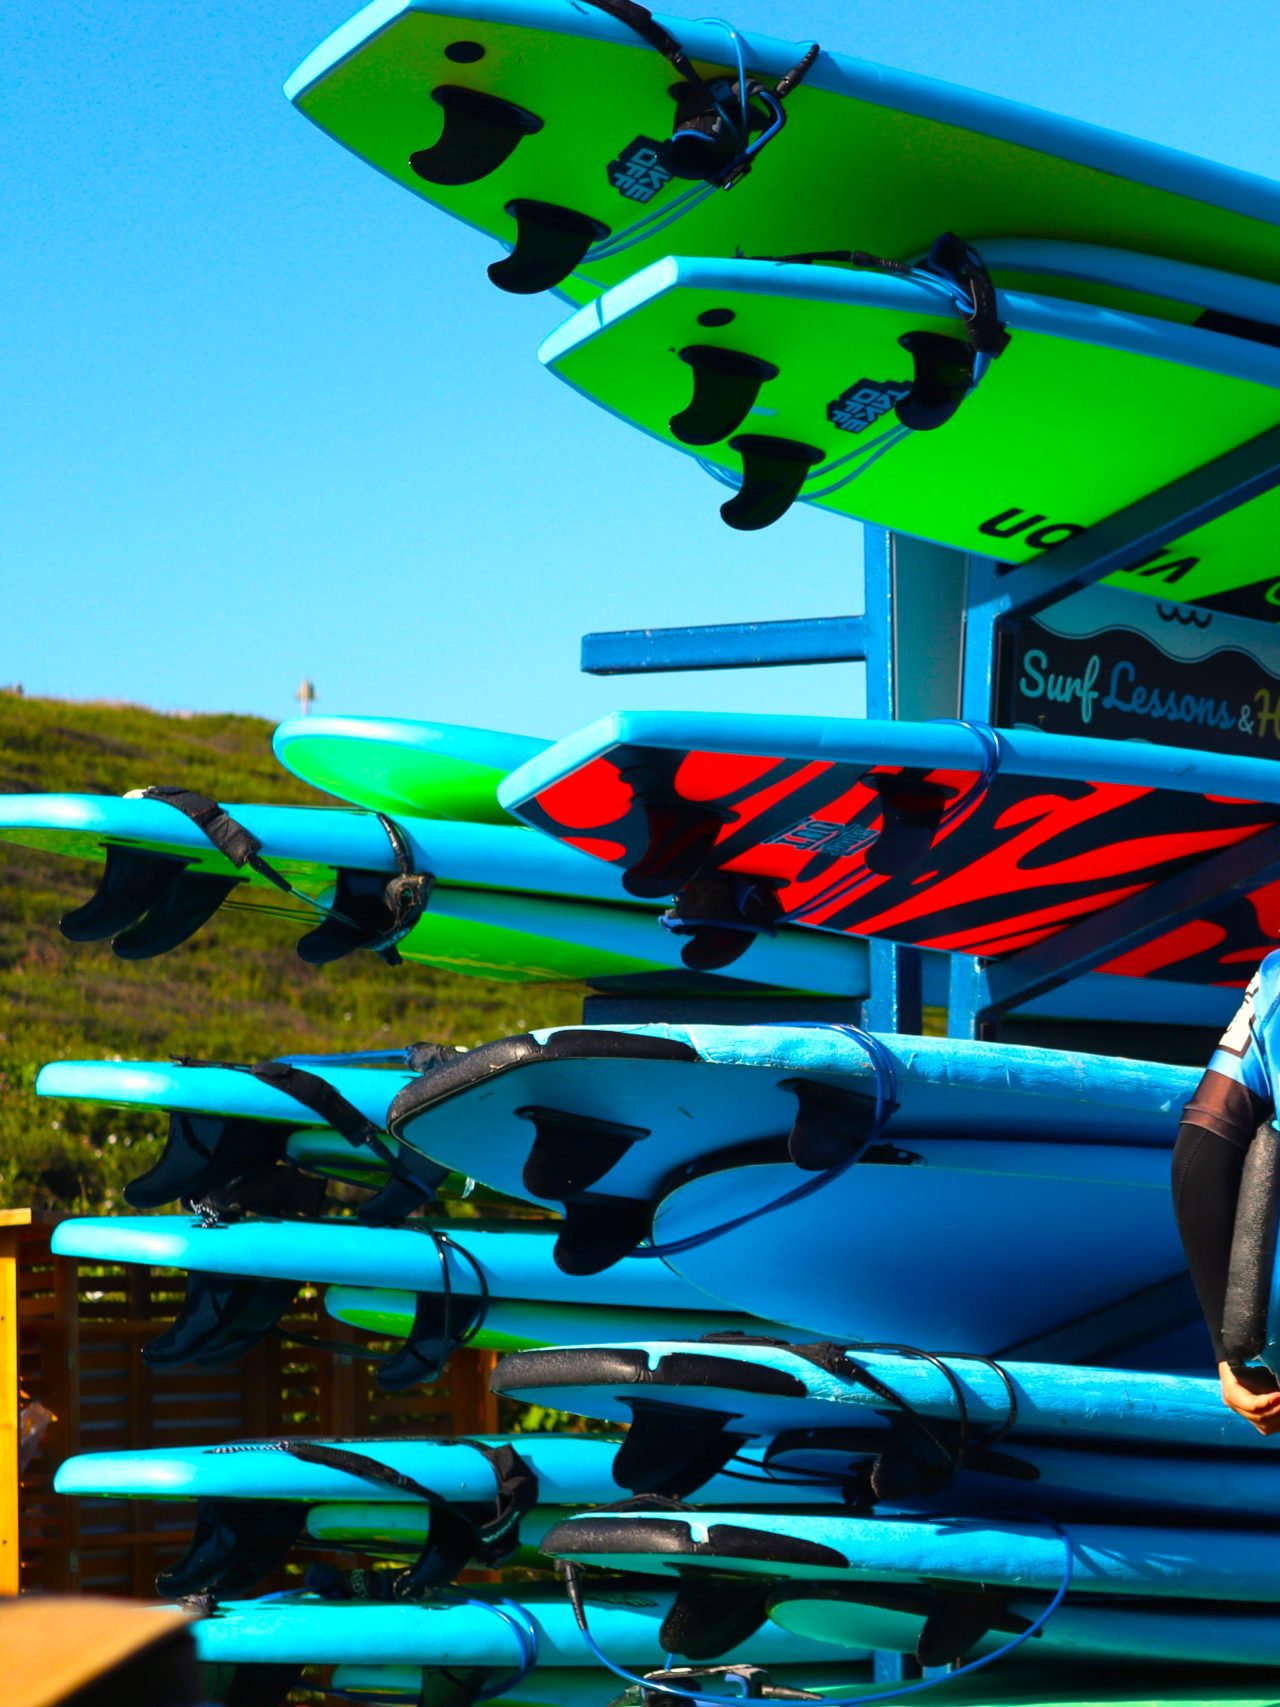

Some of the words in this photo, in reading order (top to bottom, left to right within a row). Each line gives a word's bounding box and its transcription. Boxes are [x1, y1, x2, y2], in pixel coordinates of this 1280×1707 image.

[1019, 649, 1101, 724] Surf
[1102, 660, 1236, 730] Lessons
[1237, 704, 1255, 735] &
